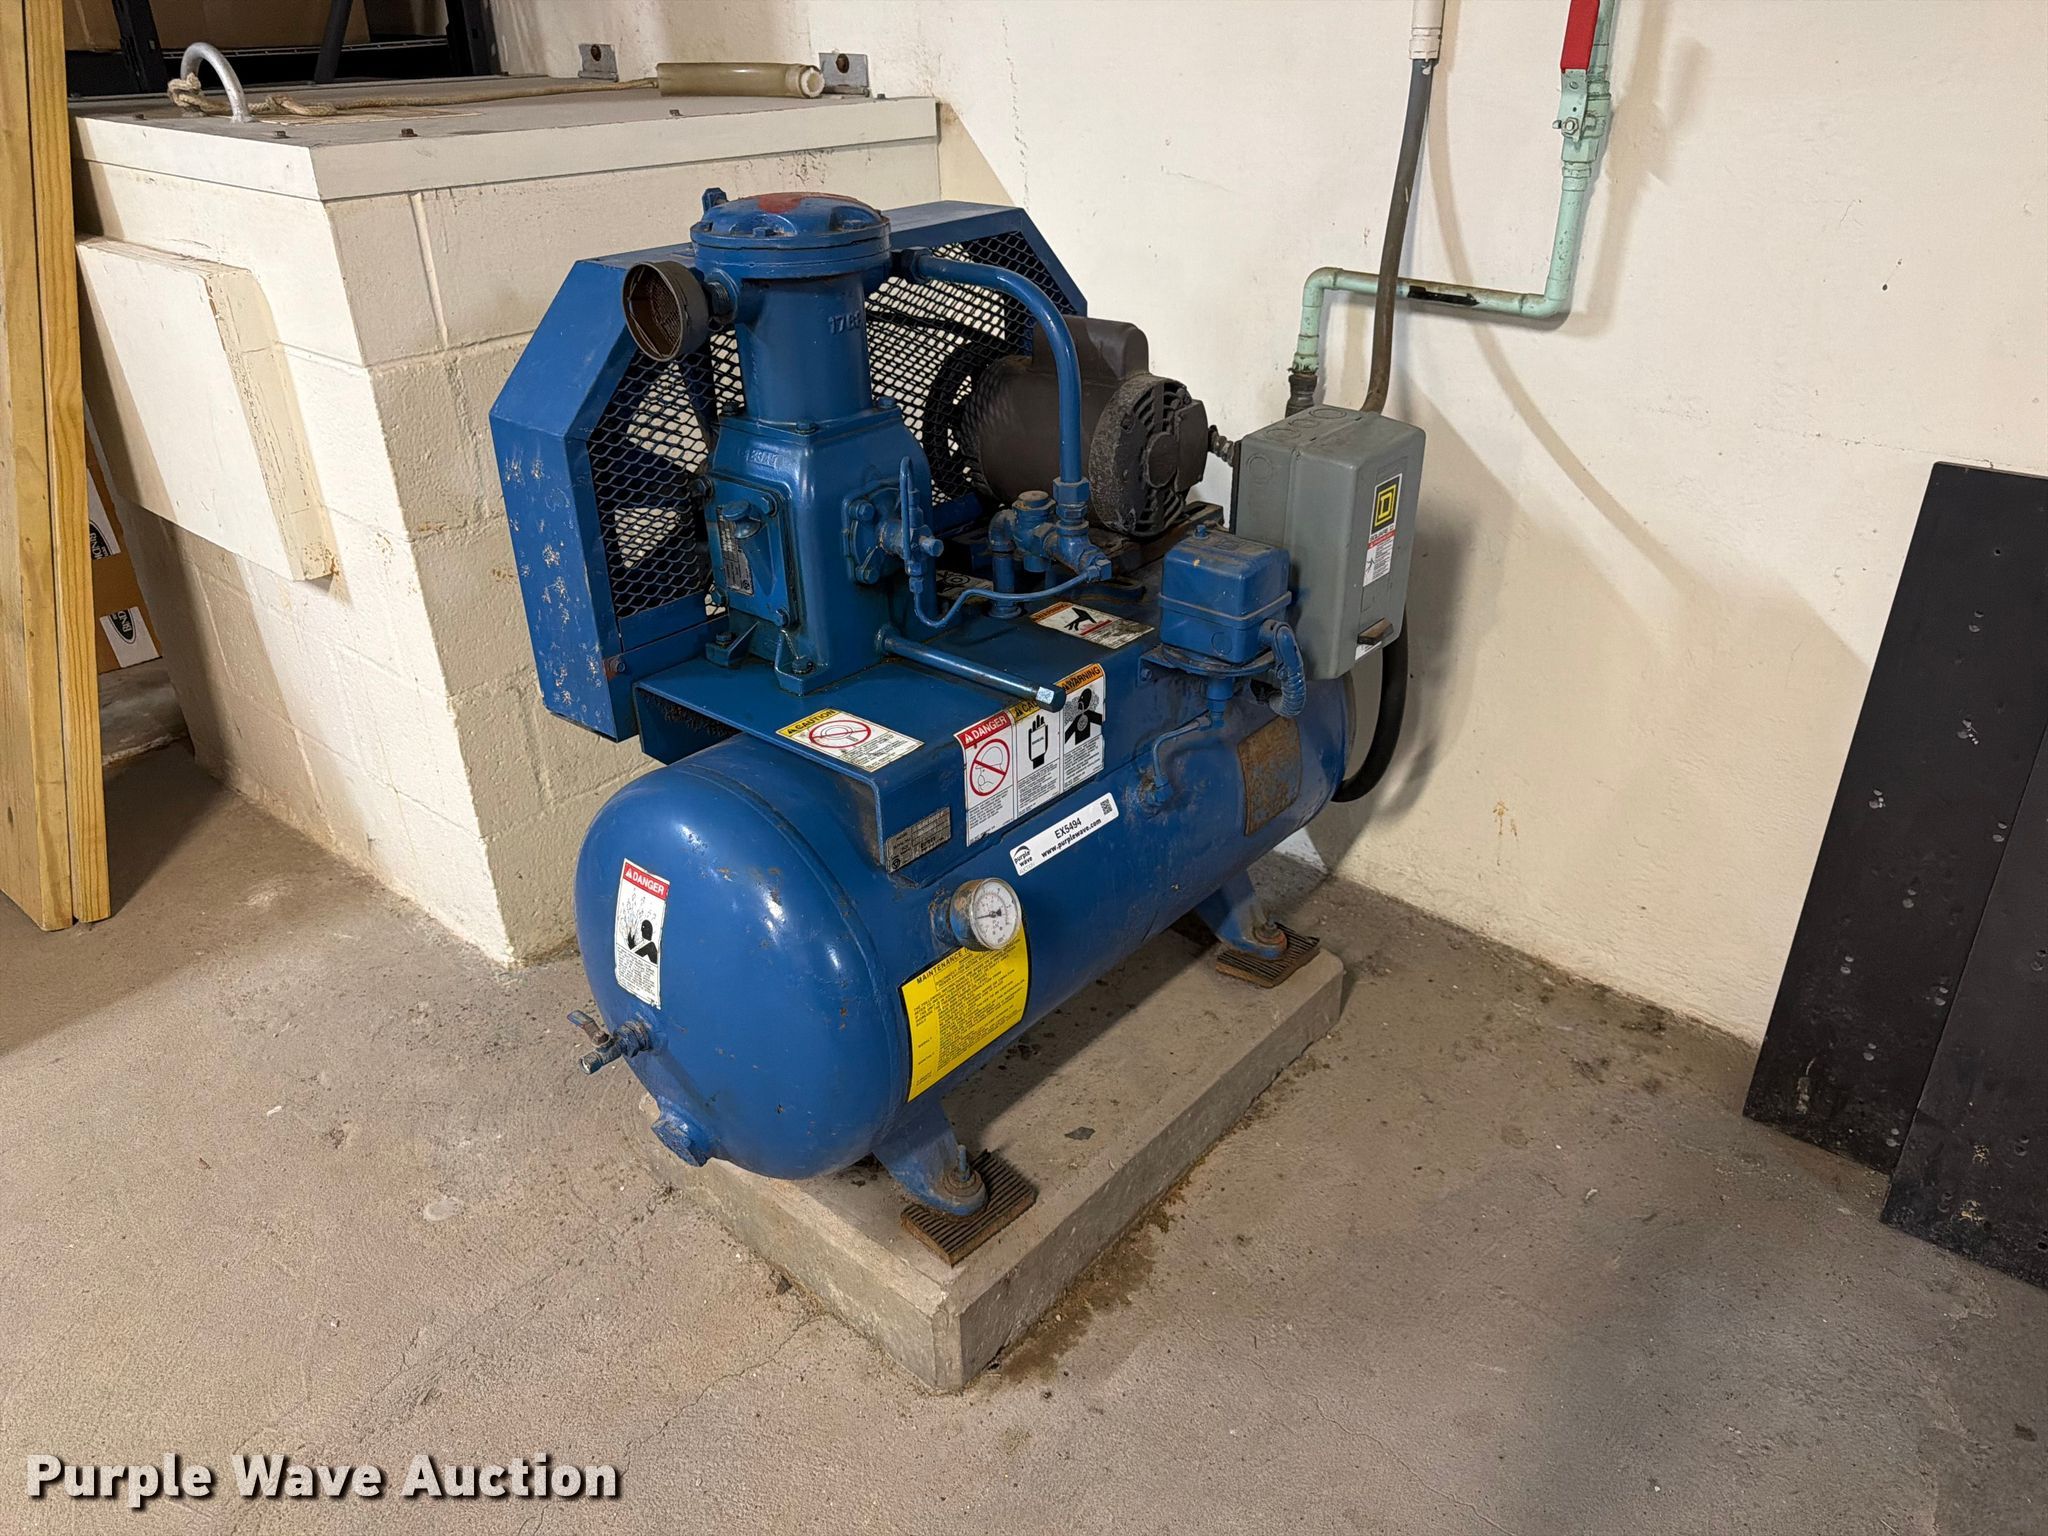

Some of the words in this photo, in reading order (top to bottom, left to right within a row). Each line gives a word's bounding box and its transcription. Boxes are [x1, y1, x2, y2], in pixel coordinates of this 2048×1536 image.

[1068, 666, 1100, 687] WARNING
[795, 710, 836, 729] CAUTION
[972, 716, 1008, 738] DANGER
[1041, 818, 1102, 858] www.purplewave.com
[1054, 817, 1082, 839] EX5494
[1014, 850, 1031, 863] purple
[1019, 856, 1033, 867] wave
[632, 872, 665, 895] DANGER
[916, 951, 964, 985] MAINTENANCE
